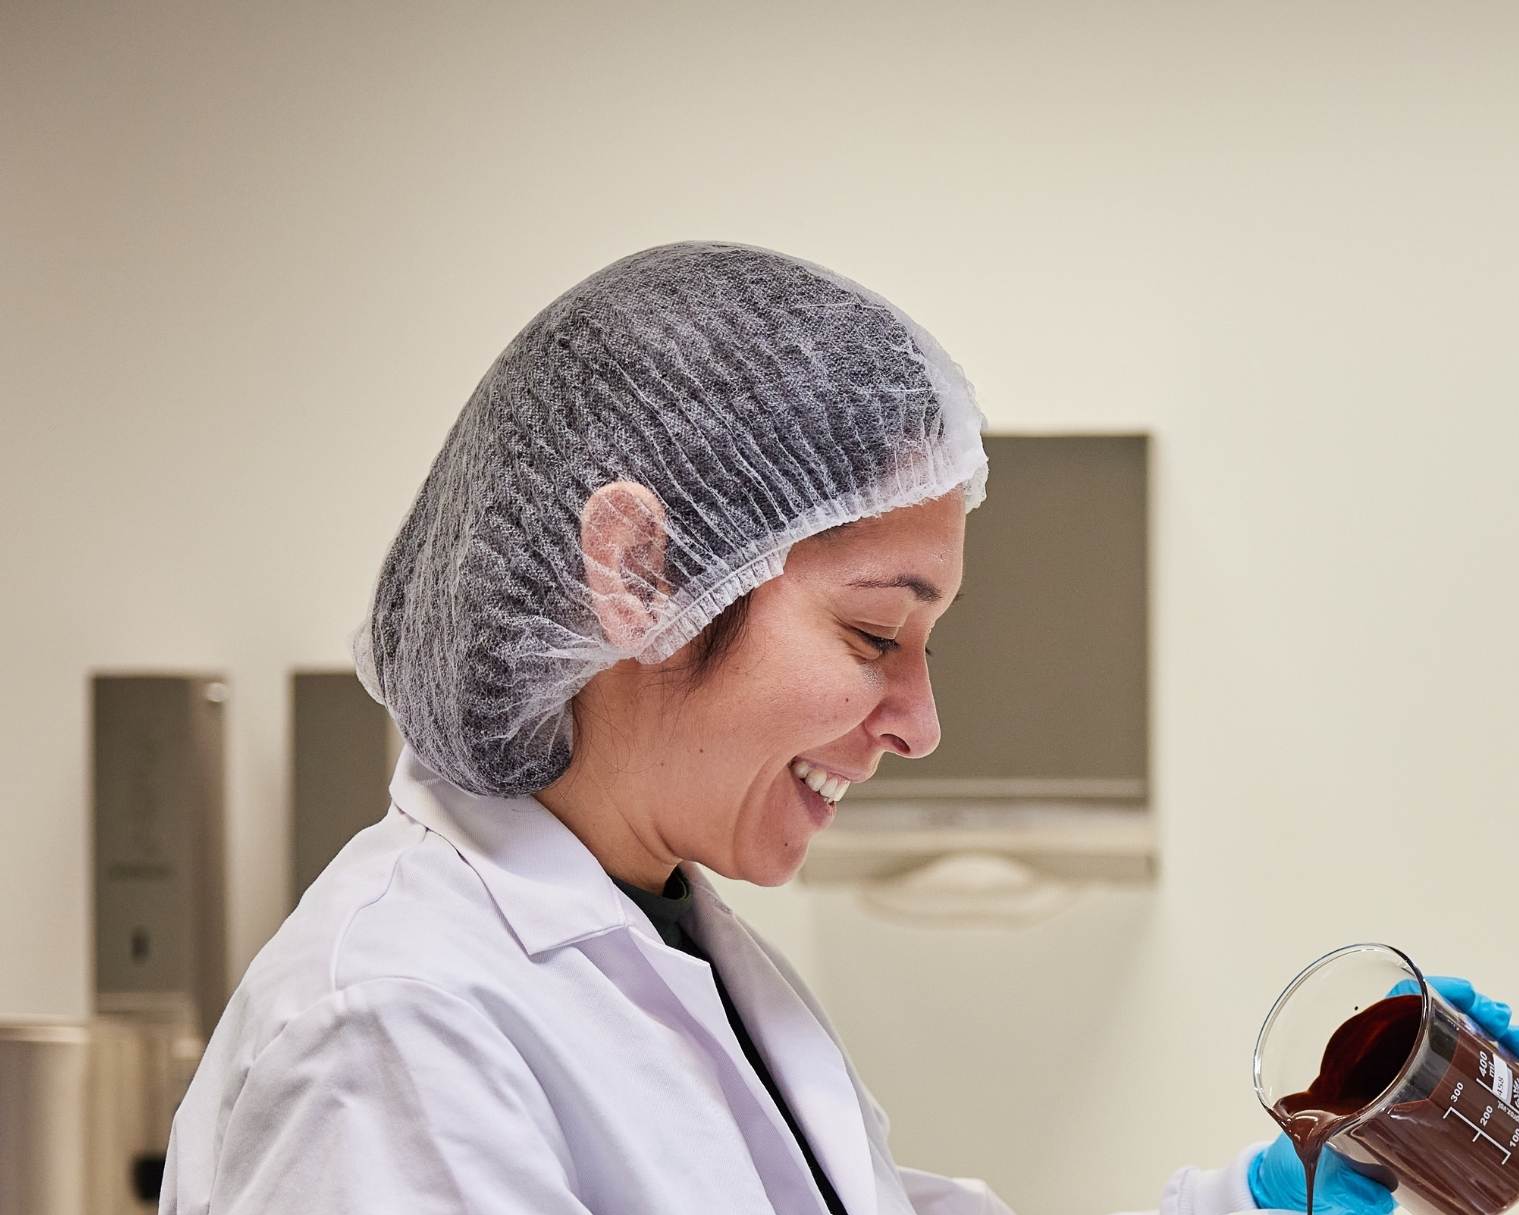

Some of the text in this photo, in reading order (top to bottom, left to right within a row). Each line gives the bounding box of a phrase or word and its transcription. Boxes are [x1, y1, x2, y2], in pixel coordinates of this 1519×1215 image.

[1479, 1050, 1488, 1078] 400
[1450, 1082, 1464, 1103] 300
[1480, 1105, 1494, 1127] 200
